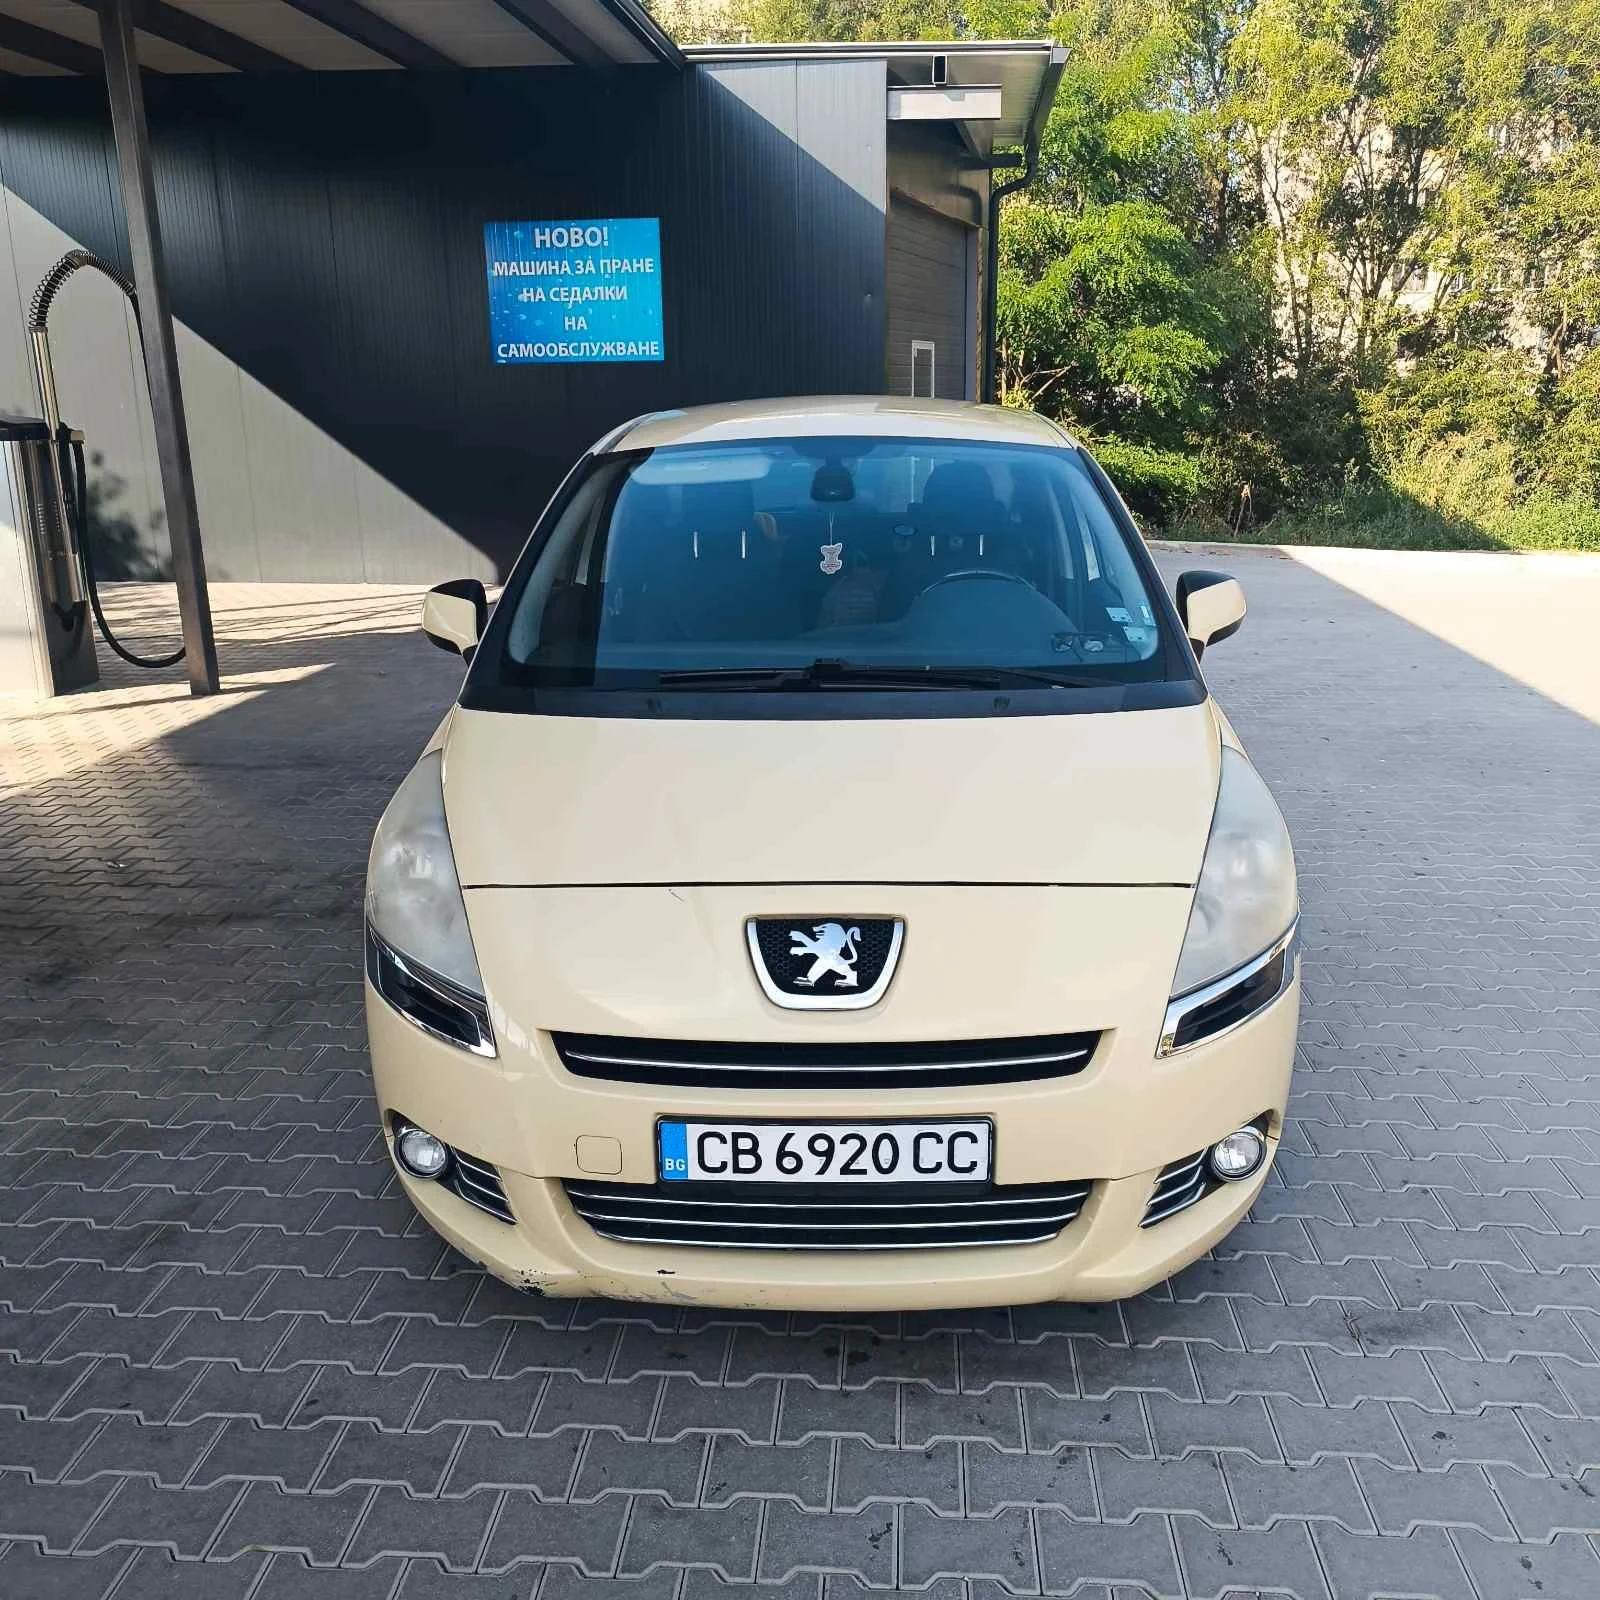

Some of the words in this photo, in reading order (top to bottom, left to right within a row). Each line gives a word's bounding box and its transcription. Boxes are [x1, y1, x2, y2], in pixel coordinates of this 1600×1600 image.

[534, 226, 609, 248] НОВО!
[493, 260, 571, 276] МАШИНА
[575, 259, 596, 275] ЗА
[600, 258, 654, 274] ПРАНЕ
[523, 287, 546, 302] НА
[550, 286, 628, 303] СЕДАЛКИ
[564, 316, 588, 331] НА
[497, 341, 660, 358] САМООБСЛУЖВАНЕ
[696, 1130, 763, 1175] CB
[775, 1131, 900, 1176] 6920
[912, 1130, 979, 1174] CC
[664, 1157, 687, 1171] BG
